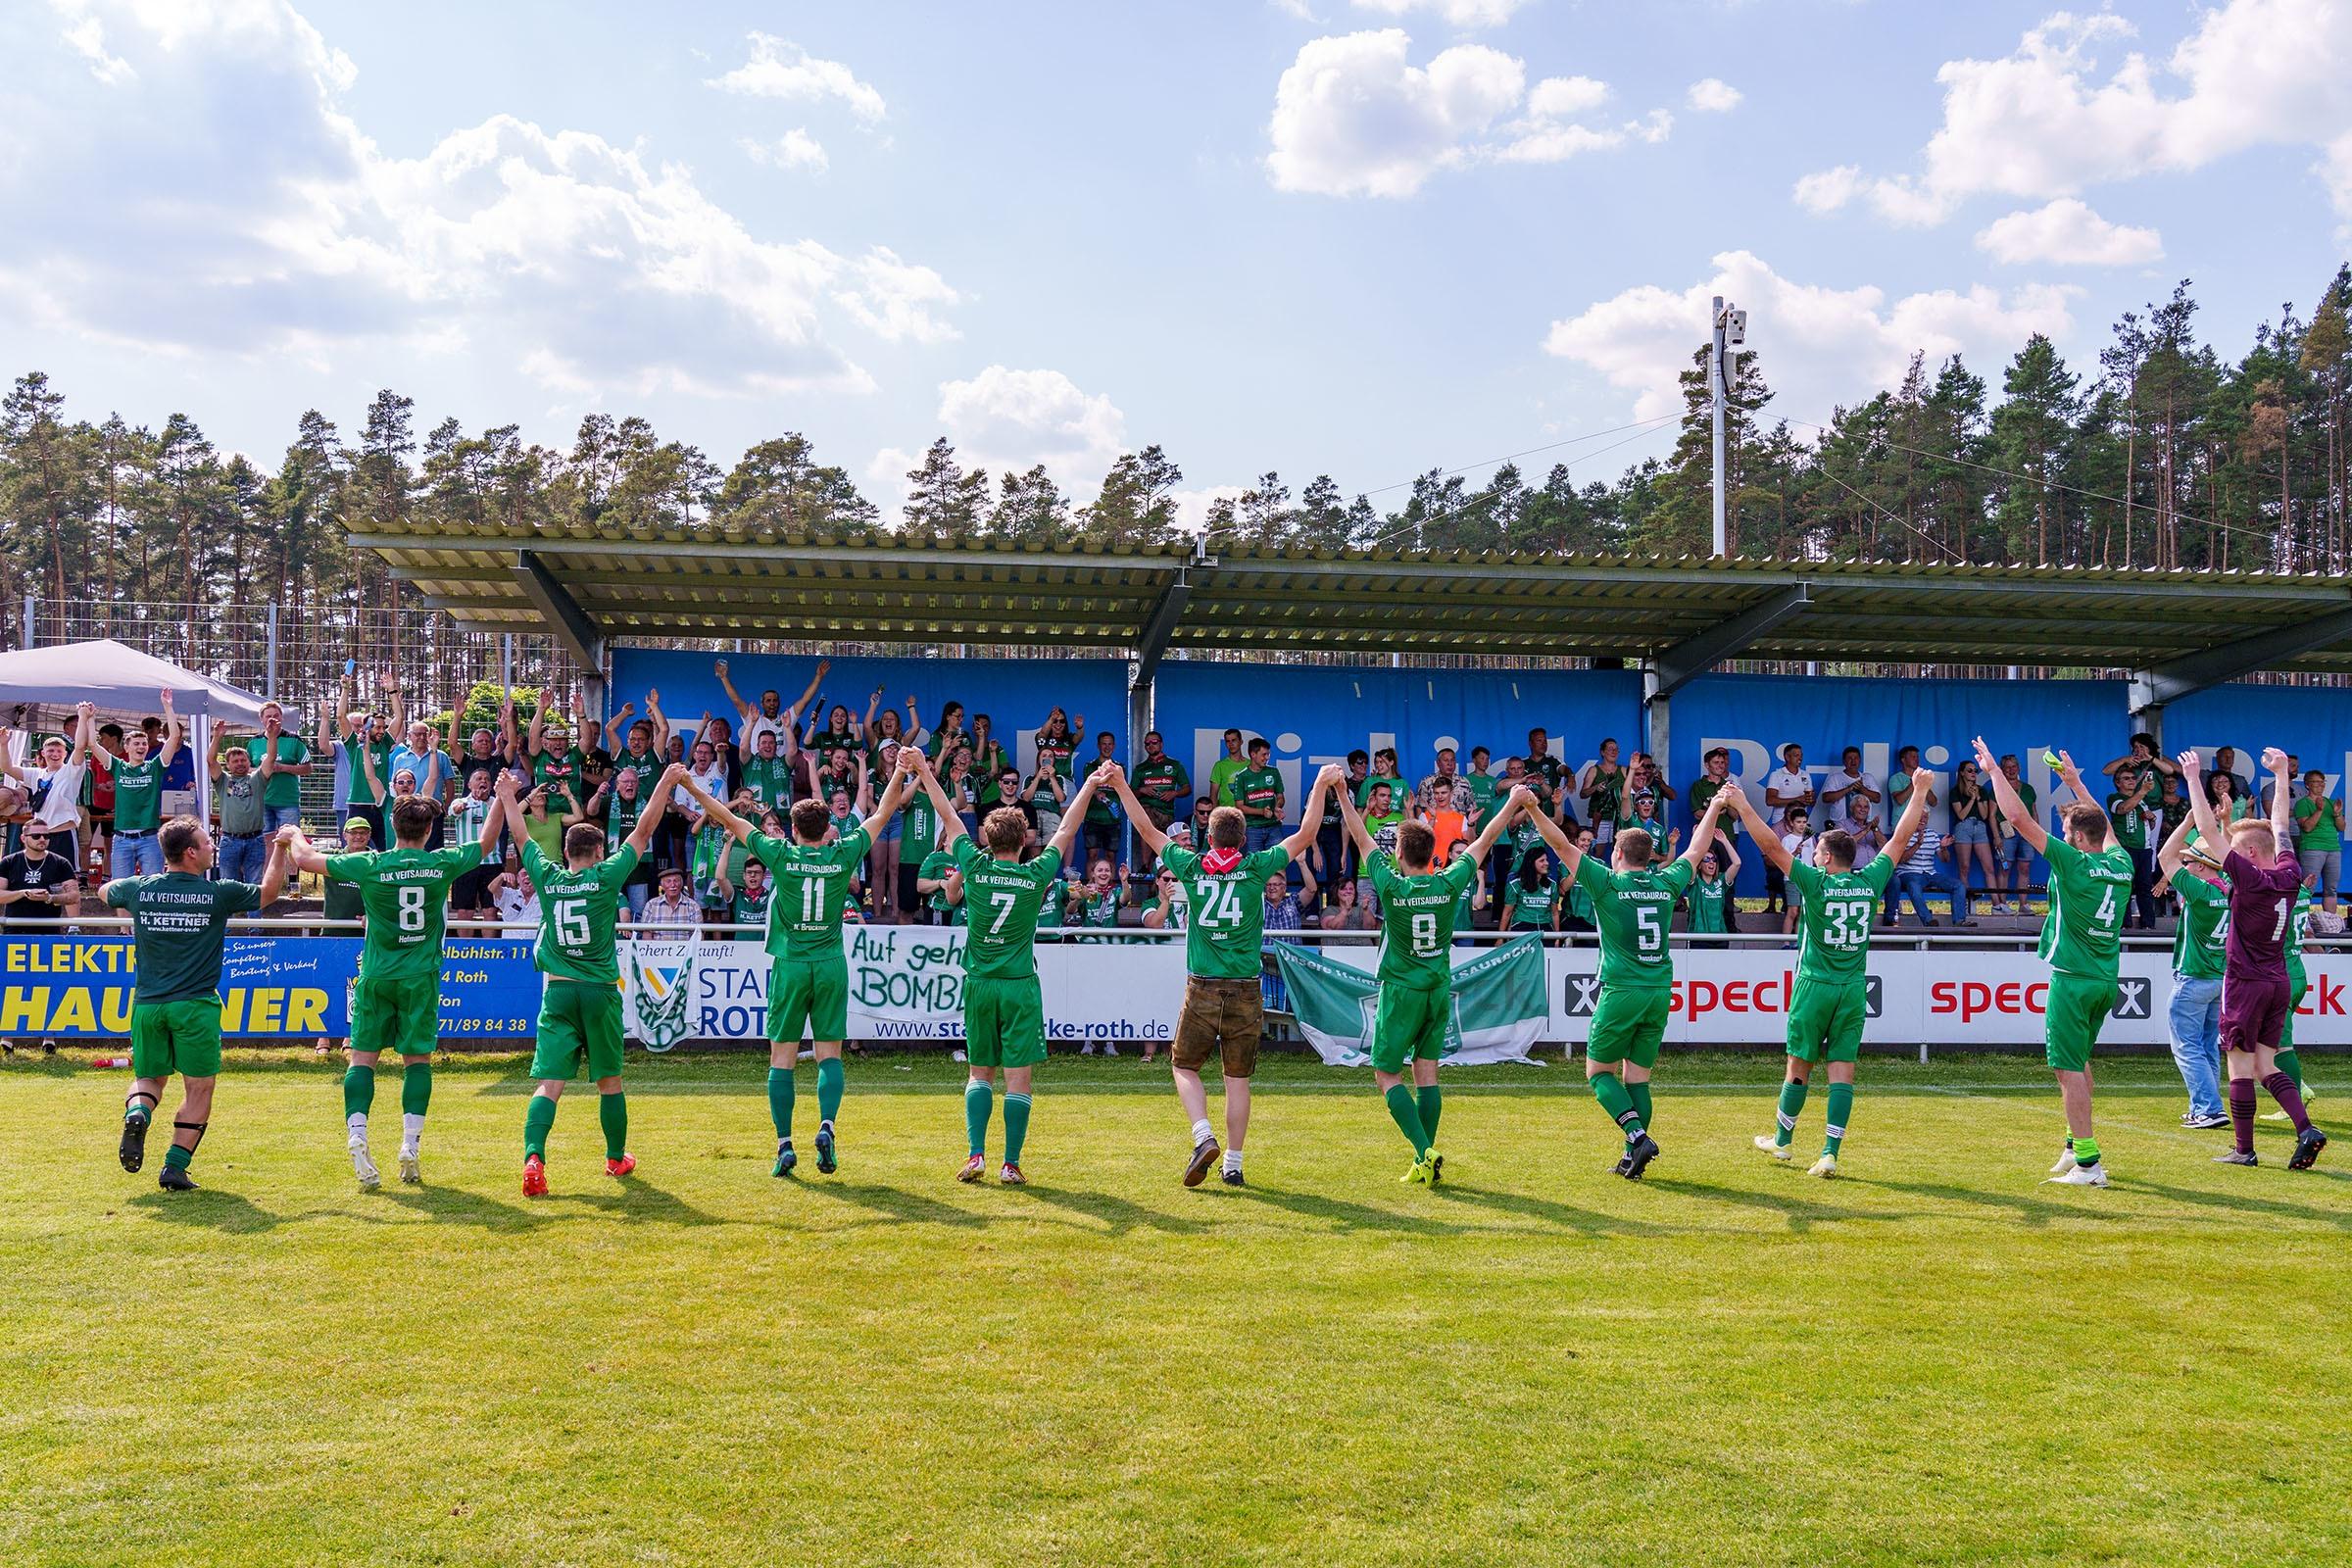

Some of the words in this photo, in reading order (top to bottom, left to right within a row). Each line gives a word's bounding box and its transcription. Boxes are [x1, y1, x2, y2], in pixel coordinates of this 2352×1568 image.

[380, 872, 395, 882] DJK
[395, 868, 443, 880] VEITSAURACH
[786, 862, 800, 871] DJK
[801, 864, 842, 873] VEITSAURACH
[975, 874, 989, 883] DJK
[990, 876, 1036, 890] VEITSAURACH
[139, 891, 156, 902] DJK
[157, 893, 214, 905] VEITSAURACH
[544, 885, 555, 894] DJK
[556, 882, 600, 894] VEITSAURACH
[802, 877, 824, 921] 11
[1197, 880, 1243, 927] 24
[1393, 898, 1406, 906] DJK
[1407, 895, 1450, 907] VEITSAURACH
[1618, 891, 1631, 900] DJK
[1631, 891, 1671, 901] VEITSAURACH
[2095, 884, 2116, 928] 4
[140, 916, 150, 925] H.
[153, 917, 210, 926] KETTNER
[399, 886, 424, 930] 8
[553, 899, 591, 946] 15
[990, 892, 1016, 934] 7
[1824, 902, 1870, 944] 33
[2272, 898, 2287, 941] 1
[1412, 913, 1437, 951] 9
[1637, 906, 1661, 950] 5
[2210, 909, 2230, 944] 4
[233, 942, 245, 953] Sie
[247, 940, 276, 950] unsere
[852, 927, 896, 963] Auf
[906, 934, 966, 972] geh
[230, 966, 270, 978] Beratung
[272, 962, 280, 972] &
[284, 957, 318, 971] Verkauf
[455, 970, 488, 983] Roth
[852, 966, 966, 1013] BOMB
[1931, 981, 2049, 1023] spec
[485, 1018, 504, 1032] 84
[509, 1018, 527, 1032] 38
